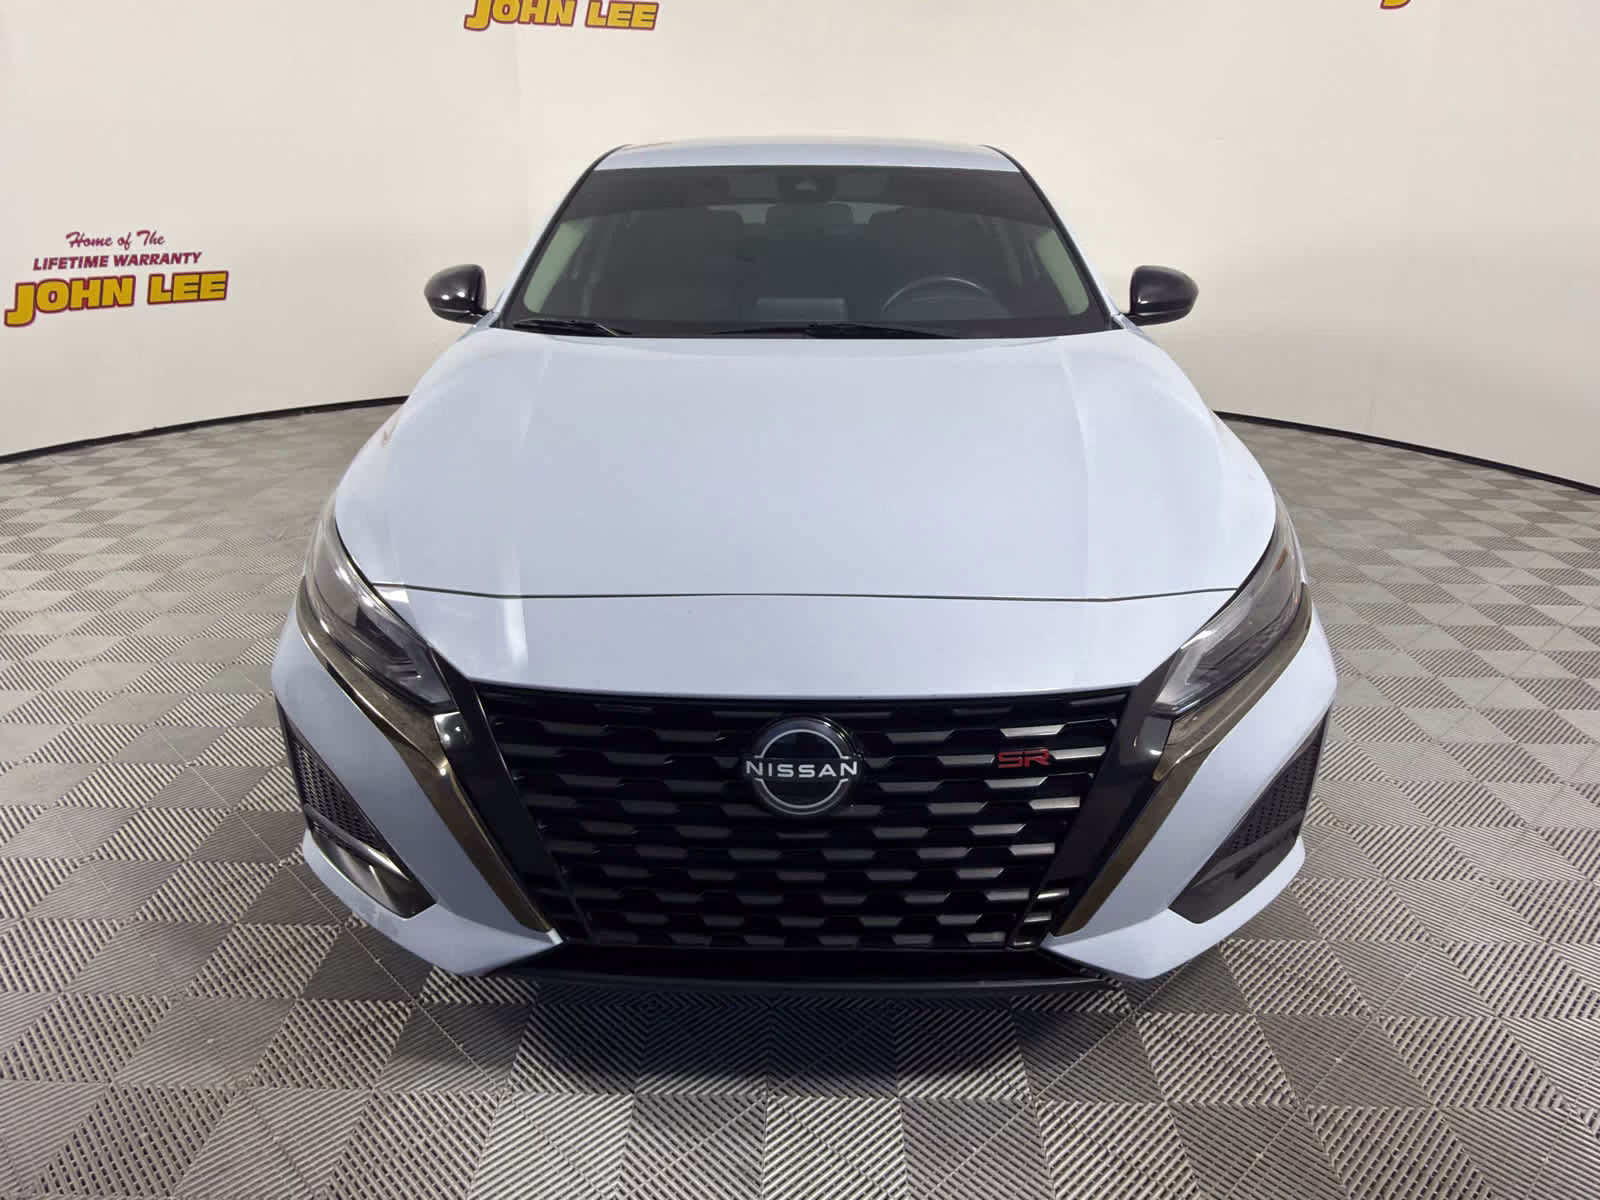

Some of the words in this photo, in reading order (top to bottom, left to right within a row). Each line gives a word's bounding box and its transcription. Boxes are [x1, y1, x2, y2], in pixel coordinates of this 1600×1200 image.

[464, 0, 578, 31] JOHN
[584, 0, 659, 31] LEE
[66, 231, 113, 248] Home
[117, 232, 132, 250] of
[136, 230, 165, 247] The
[33, 255, 109, 271] LIFETIME
[113, 251, 202, 267] WARRANTY
[4, 274, 136, 327] JOHN
[147, 271, 229, 305] LEE
[997, 747, 1050, 768] SR
[745, 760, 858, 778] NISSAN
